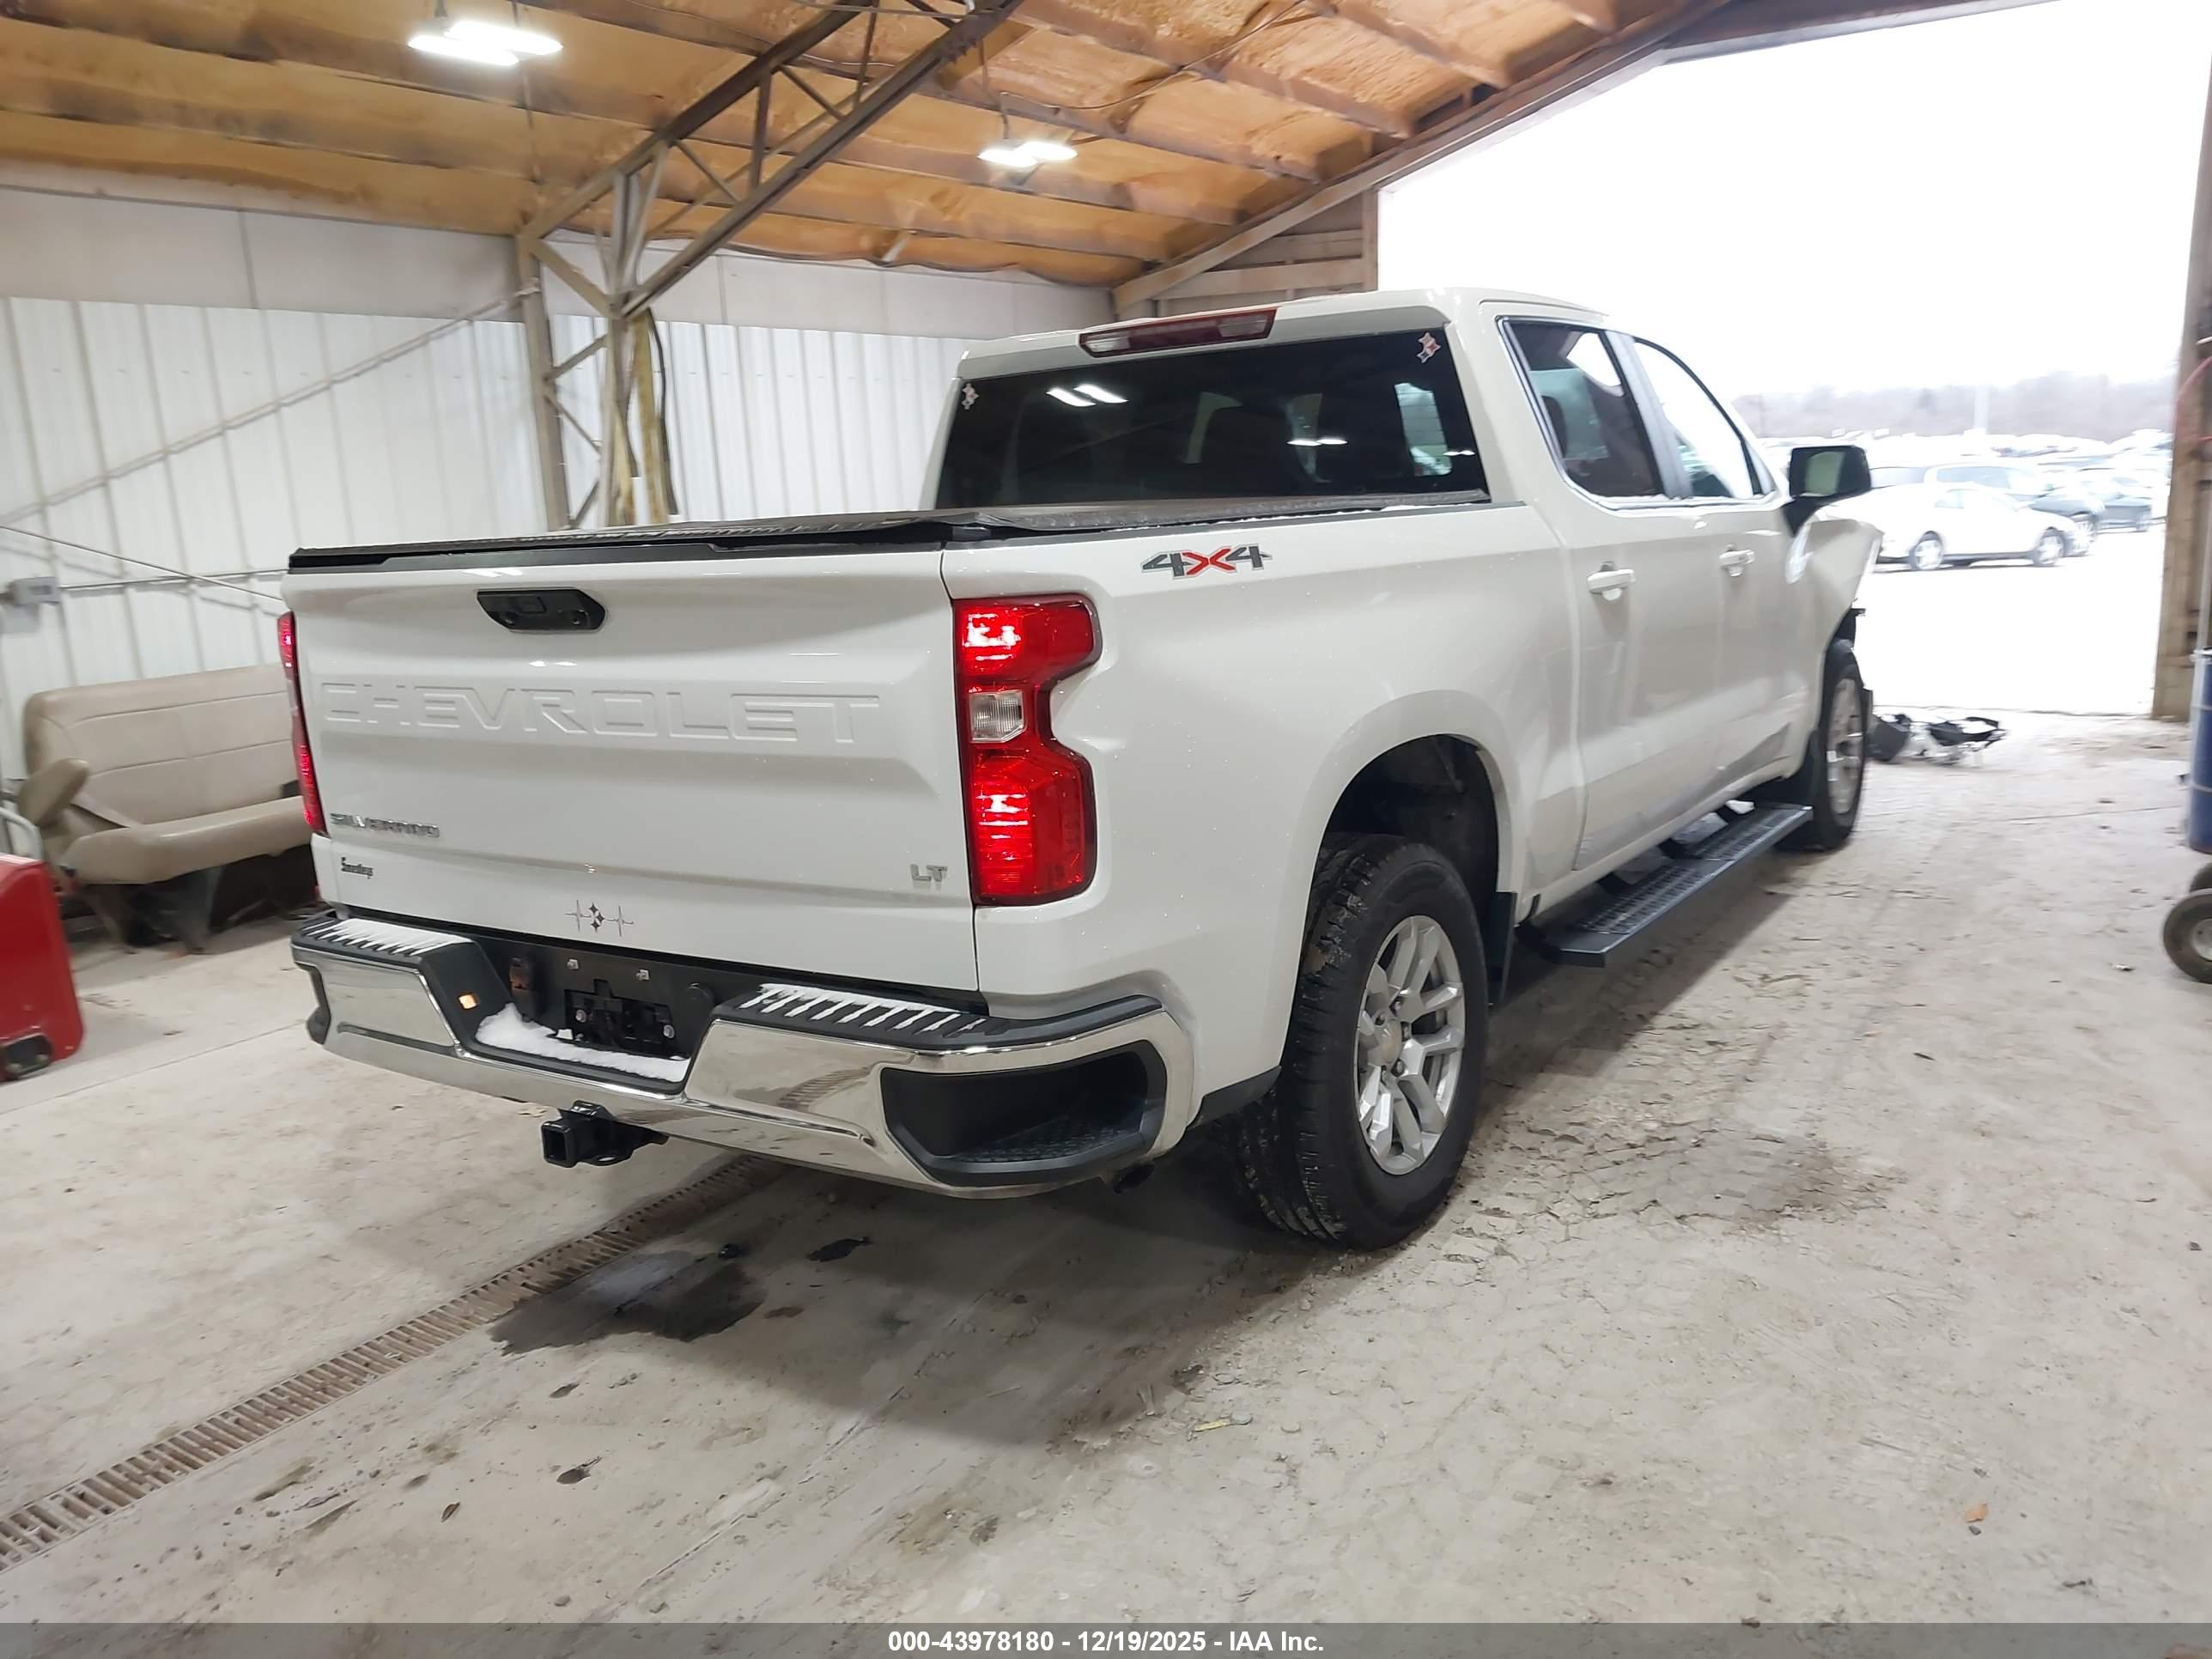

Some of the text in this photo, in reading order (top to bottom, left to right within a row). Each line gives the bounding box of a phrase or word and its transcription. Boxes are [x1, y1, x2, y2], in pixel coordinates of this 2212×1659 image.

[1141, 543, 1273, 580] 4X4
[321, 682, 880, 744] CHEVROLET
[330, 812, 441, 839] SILVERADO
[910, 863, 949, 883] LT
